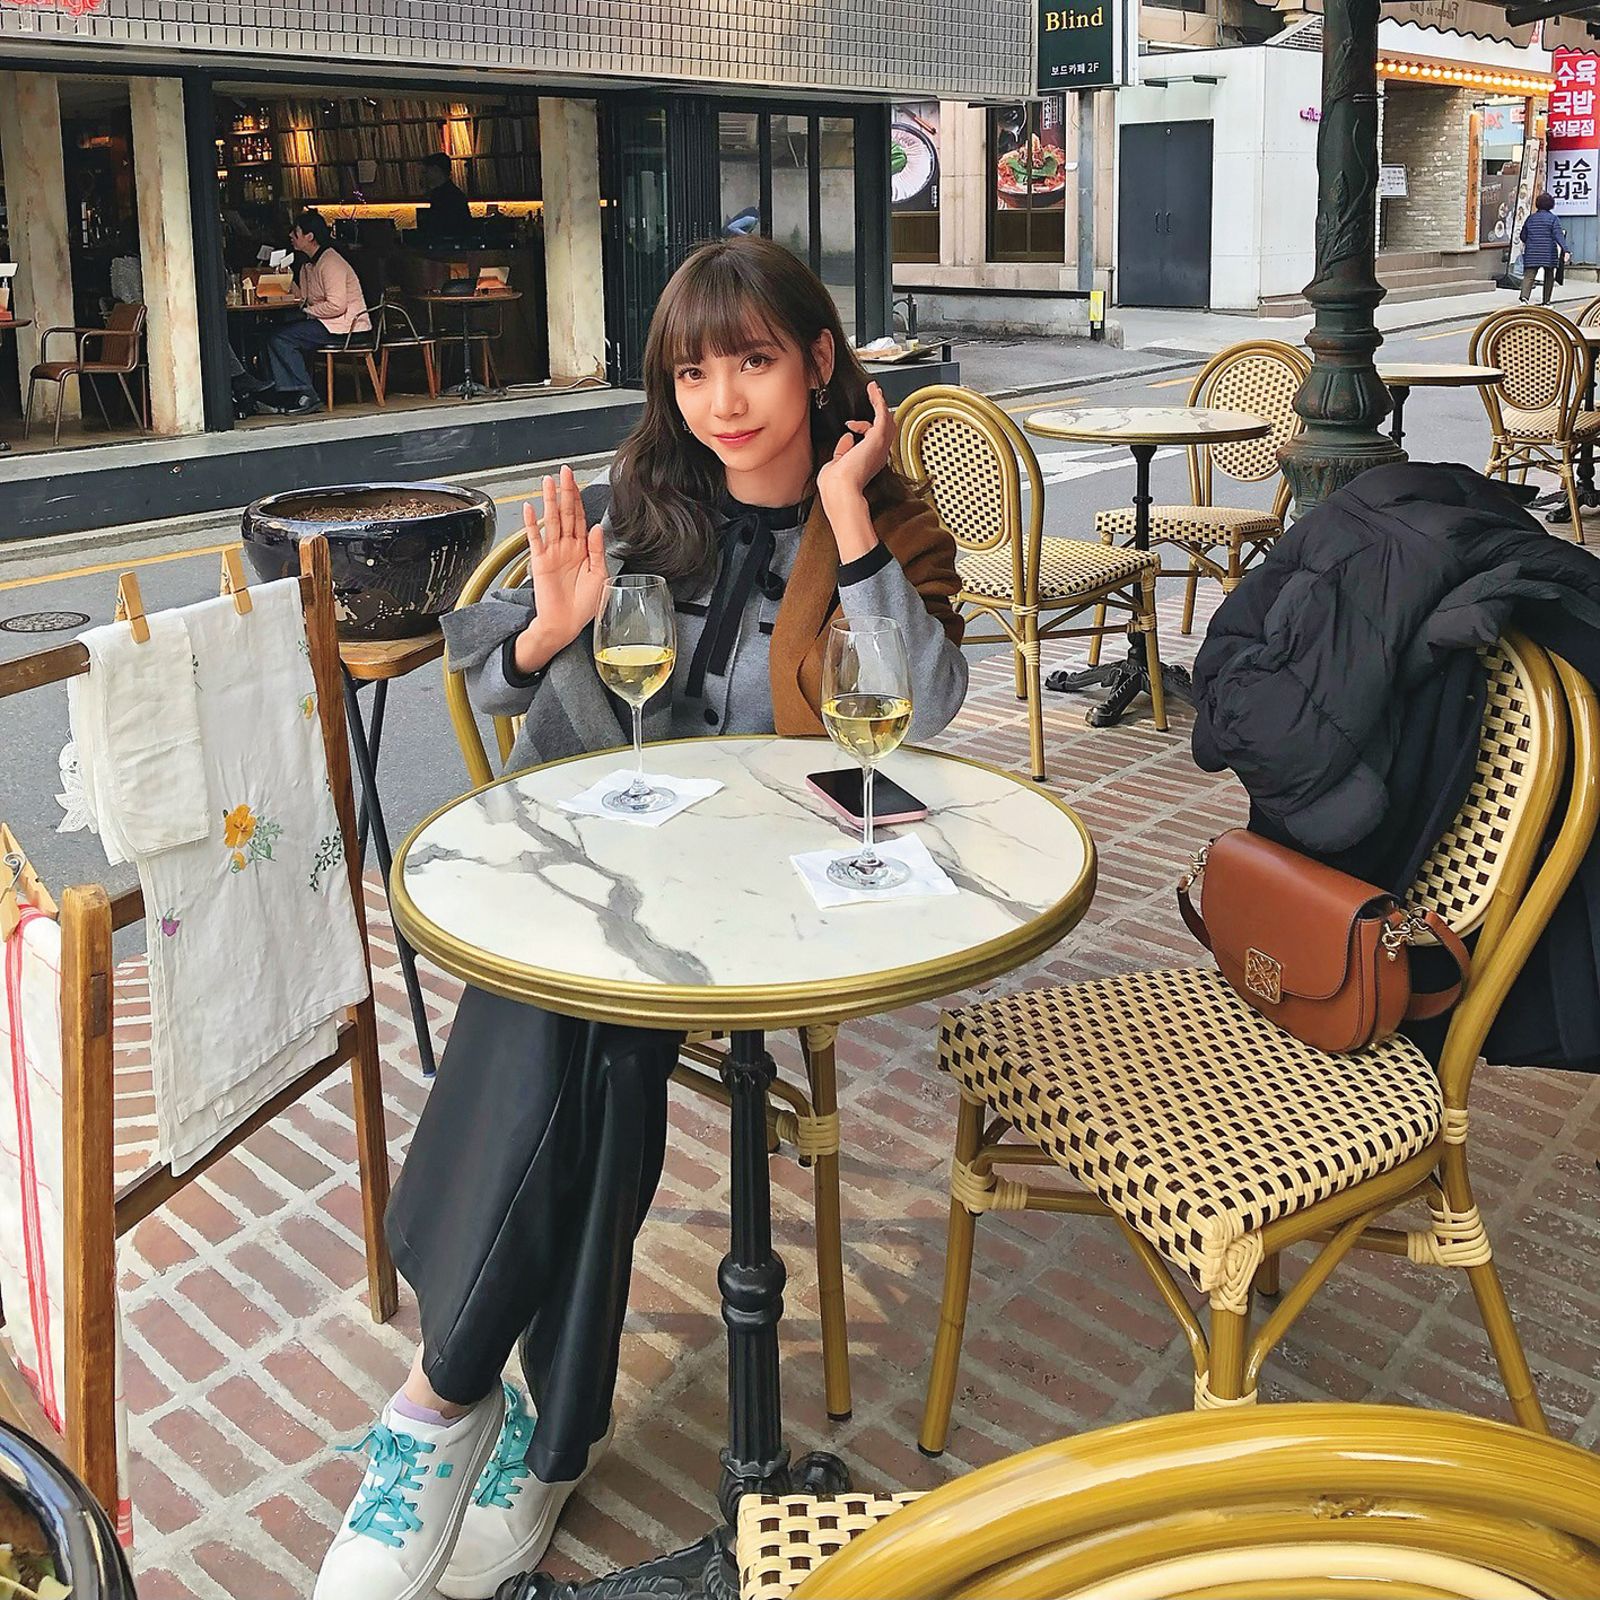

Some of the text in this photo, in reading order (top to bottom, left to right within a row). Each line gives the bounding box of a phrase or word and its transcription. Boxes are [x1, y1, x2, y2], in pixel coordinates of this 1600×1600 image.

[1045, 6, 1104, 32] Blind
[1050, 62, 1100, 76] 보드카페 2F
[1557, 60, 1597, 87] 수육
[1553, 89, 1597, 116] 국밥
[1552, 119, 1595, 137] 전문점
[1552, 158, 1592, 180] 보승
[1552, 181, 1592, 200] 회관
